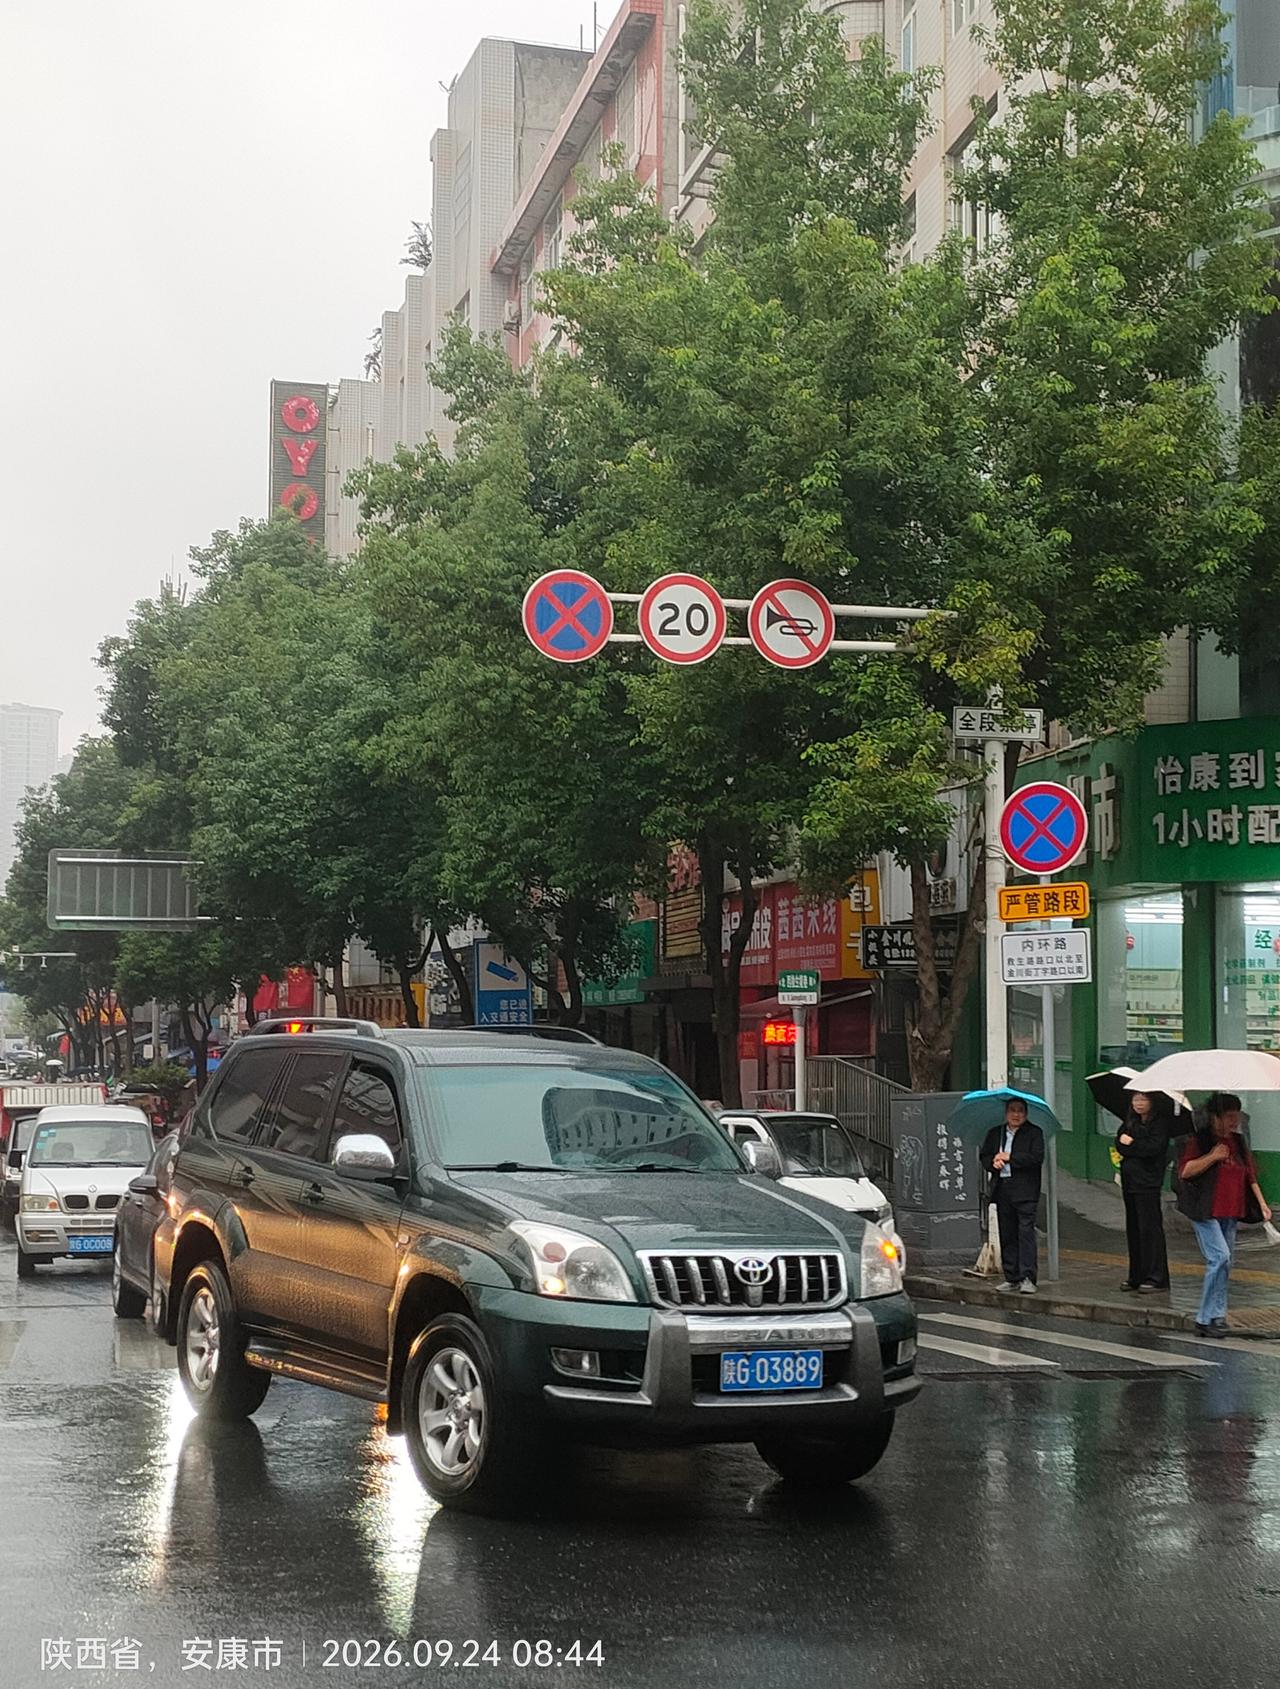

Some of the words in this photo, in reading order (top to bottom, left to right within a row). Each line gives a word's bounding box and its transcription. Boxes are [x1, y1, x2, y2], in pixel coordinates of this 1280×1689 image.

[658, 602, 709, 637] 20
[1154, 749, 1280, 796] 怡康到
[1153, 804, 1280, 848] 1小时配
[1005, 889, 1081, 916] 严管路段
[1021, 937, 1067, 953] 内环路
